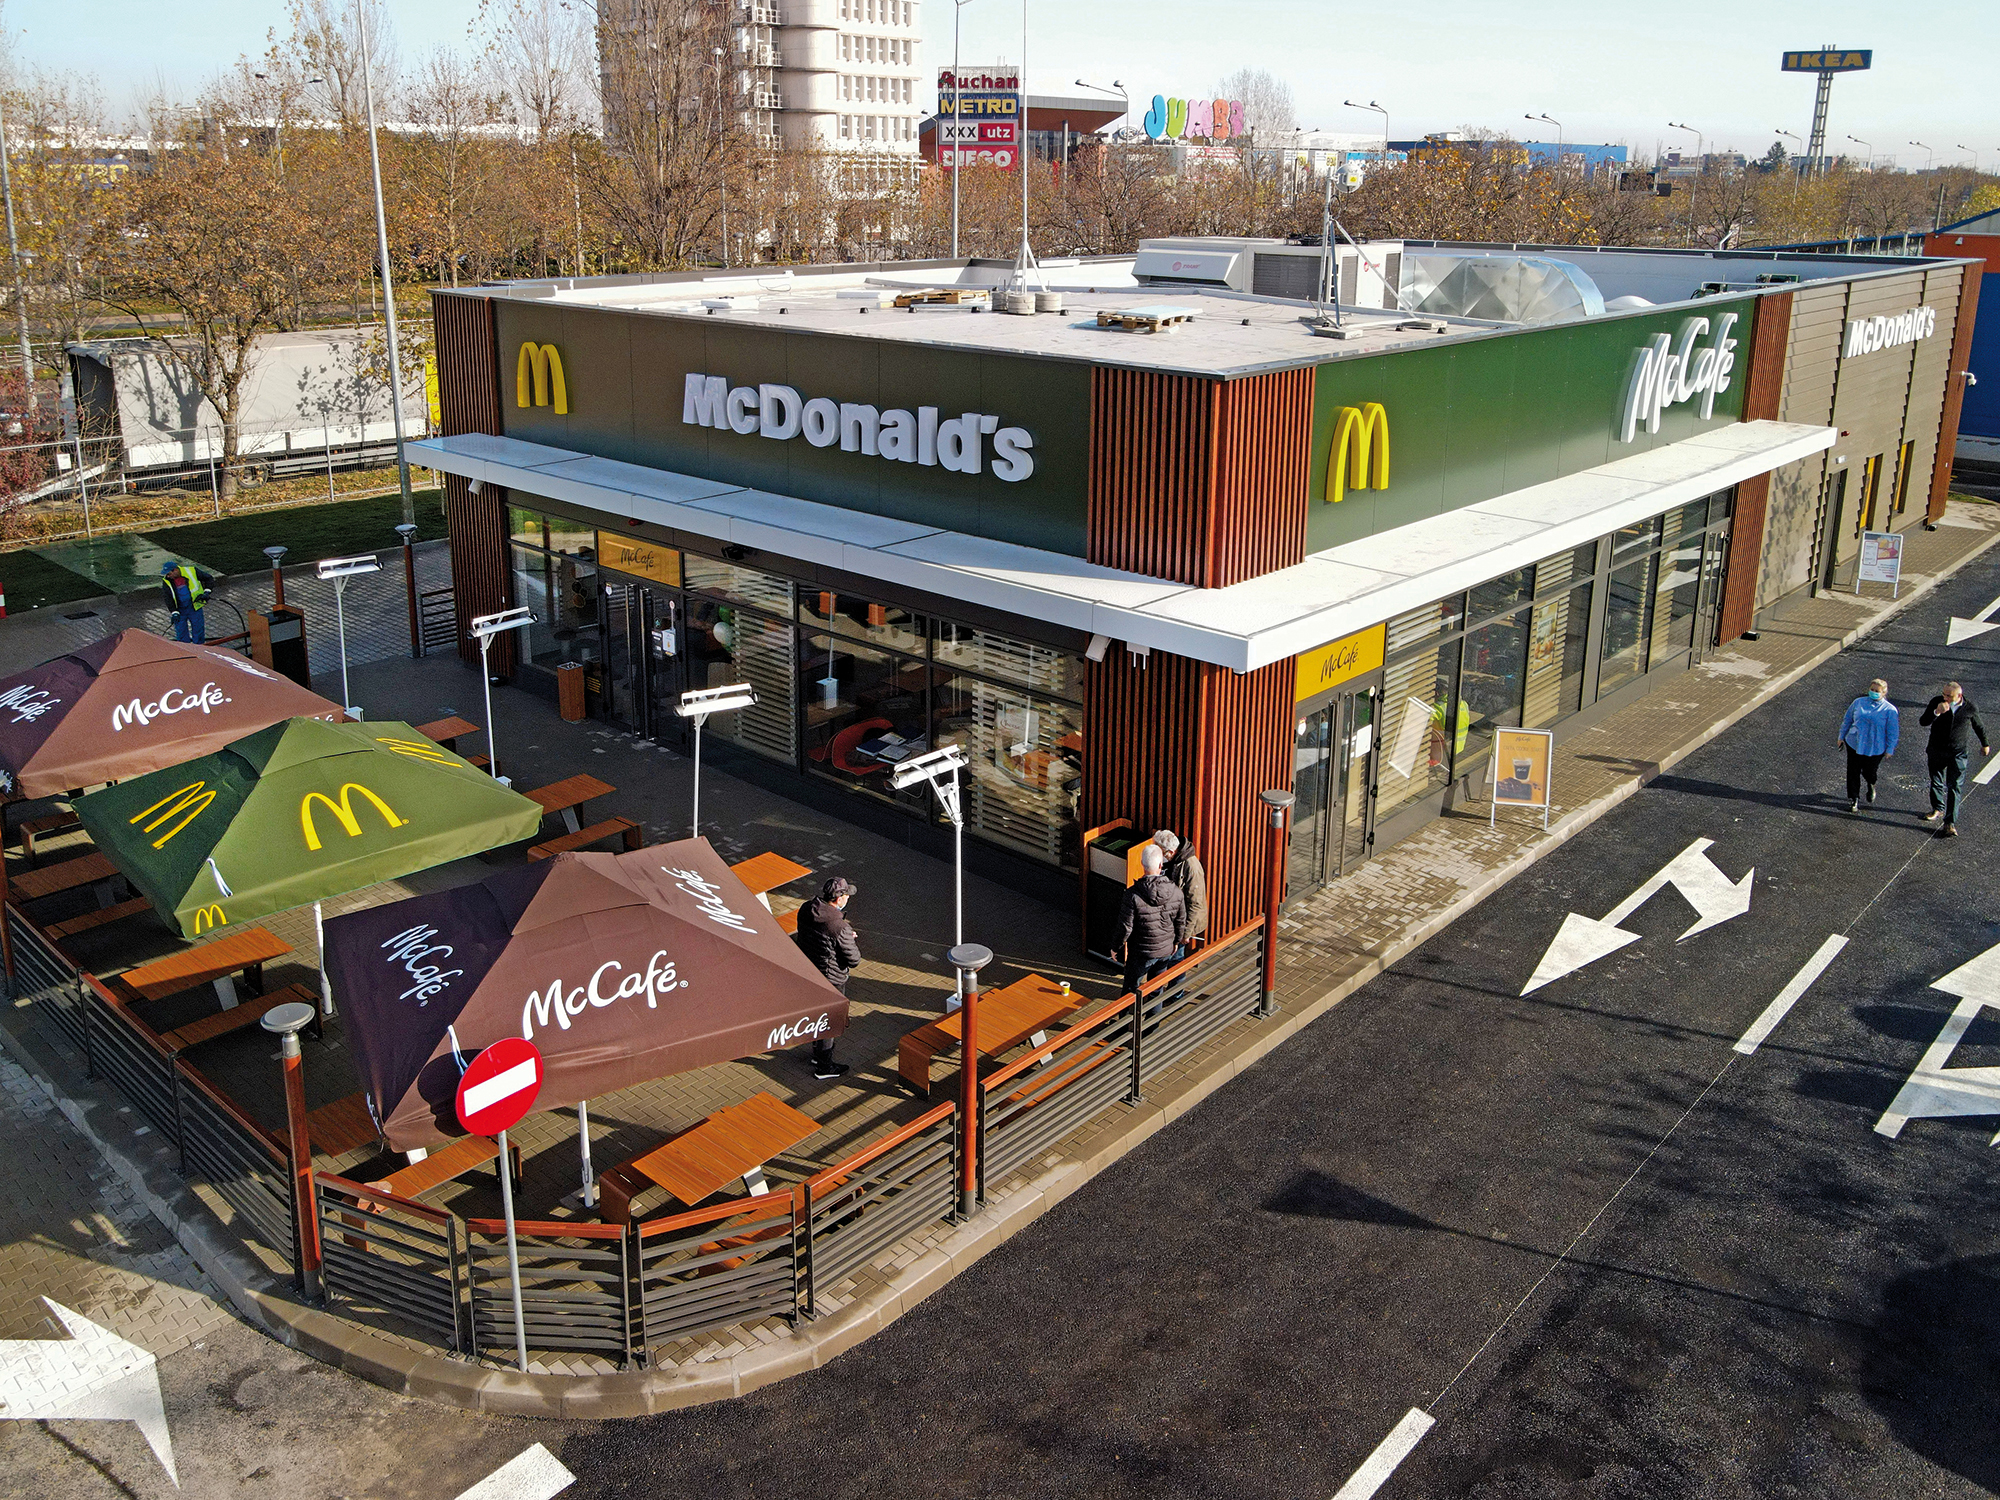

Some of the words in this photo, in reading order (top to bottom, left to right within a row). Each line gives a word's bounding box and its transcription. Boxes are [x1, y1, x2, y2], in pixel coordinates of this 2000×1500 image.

[1787, 53, 1864, 68] IKEA
[938, 71, 1019, 89] Auchan
[941, 98, 1017, 114] METRO
[1842, 306, 1936, 358] McDonald's
[1620, 312, 1739, 444] McCafé
[682, 373, 1035, 482] McDonald's
[620, 547, 655, 571] McCafé
[1320, 641, 1359, 683] McCafé
[767, 1012, 831, 1049] McCafé
